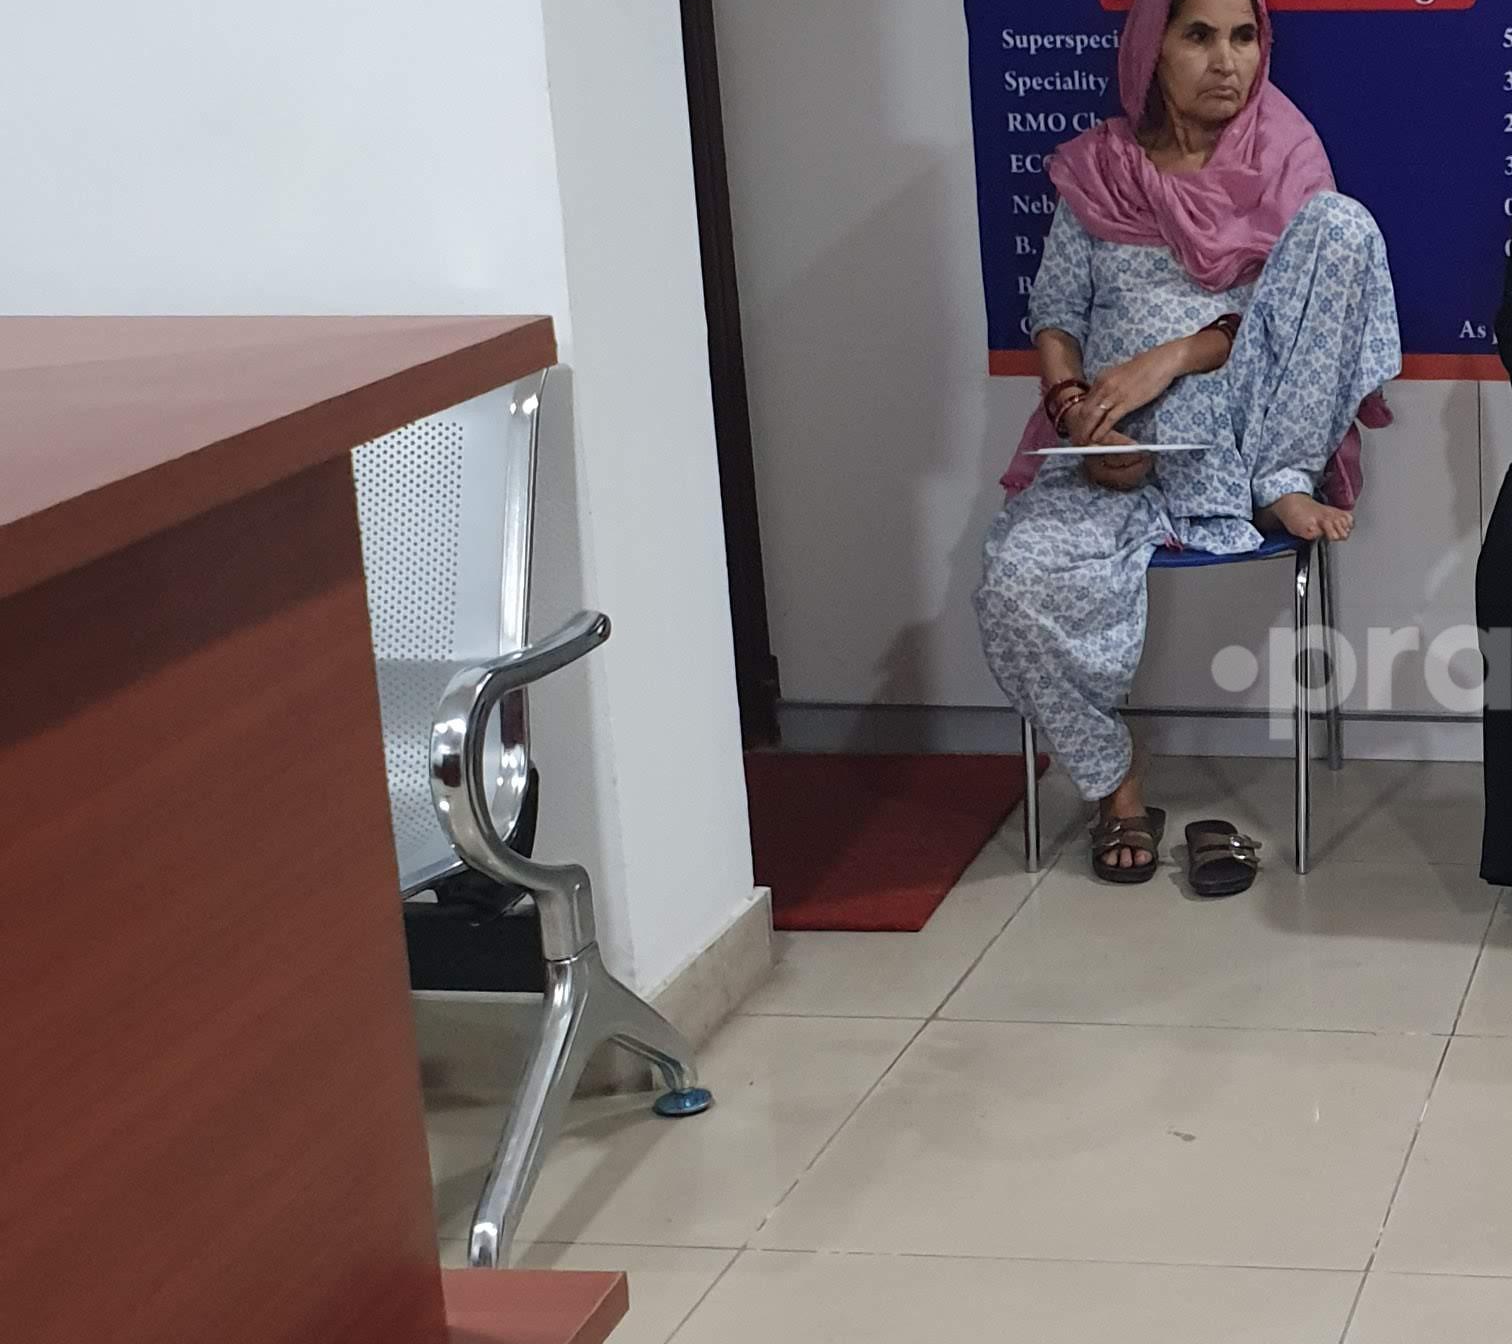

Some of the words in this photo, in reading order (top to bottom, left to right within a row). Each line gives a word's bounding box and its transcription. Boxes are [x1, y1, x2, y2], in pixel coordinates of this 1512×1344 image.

[1004, 69, 1109, 97] Speciality
[1007, 112, 1067, 133] RMO
[1459, 320, 1487, 339] As
